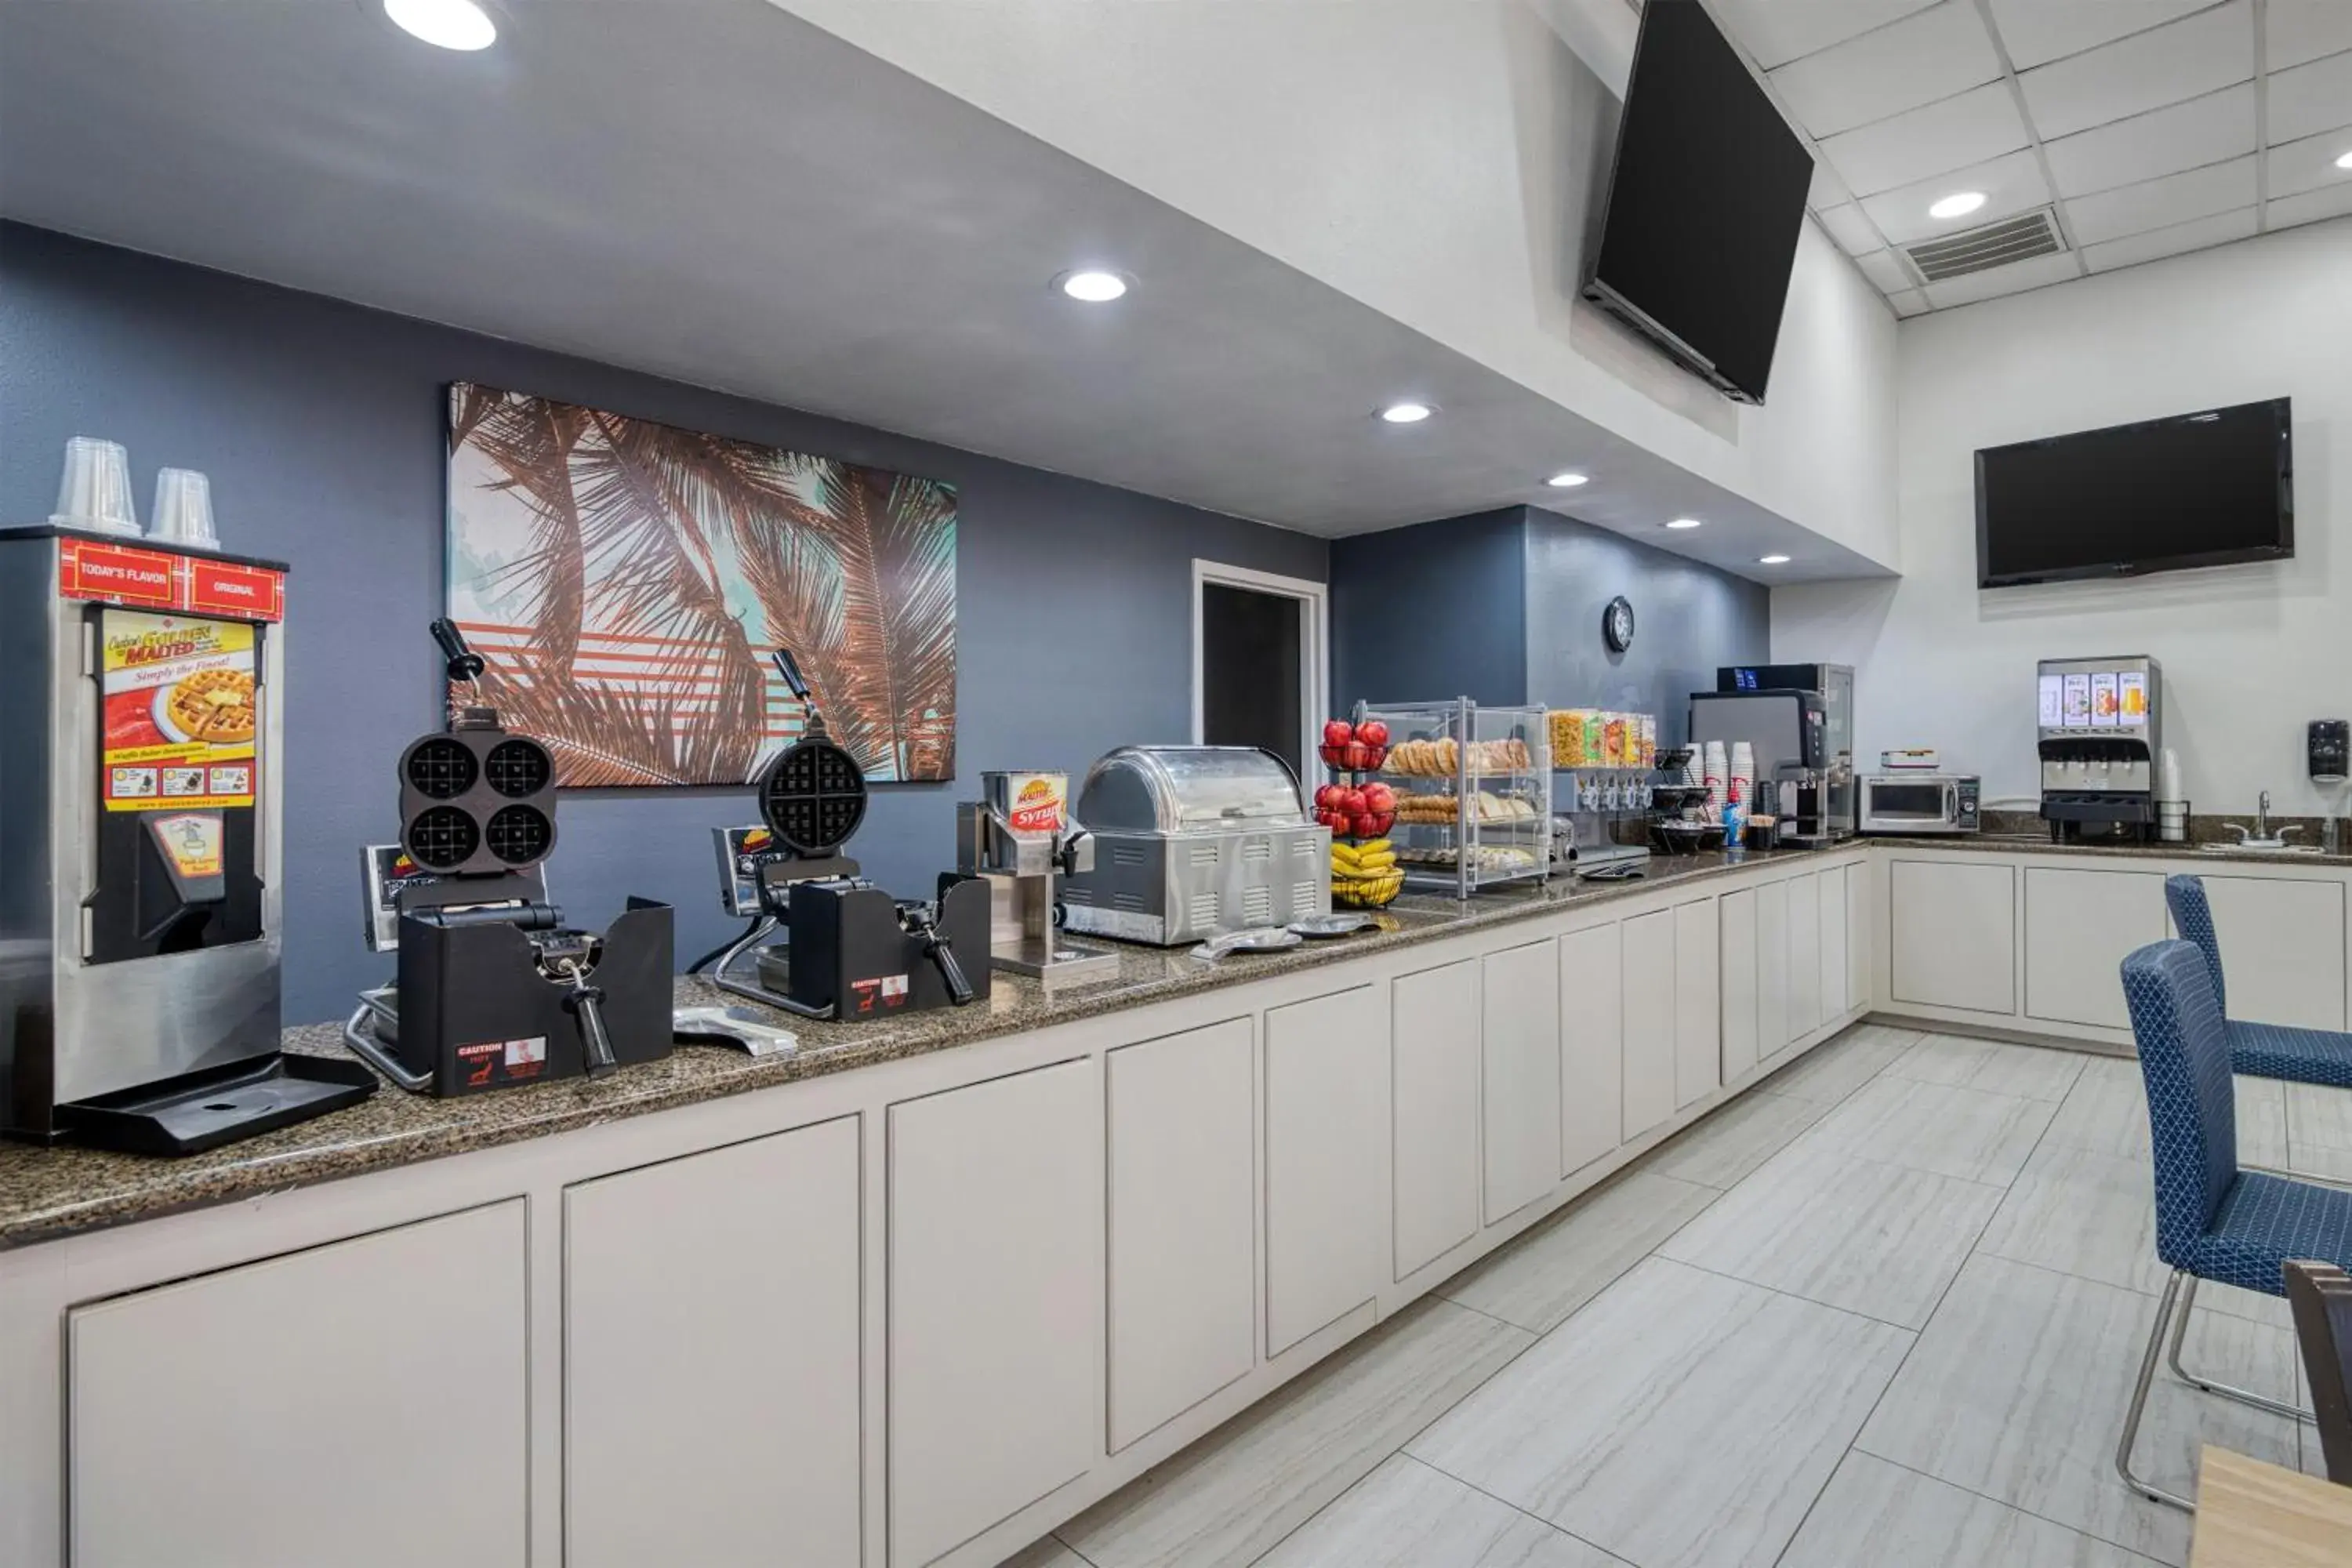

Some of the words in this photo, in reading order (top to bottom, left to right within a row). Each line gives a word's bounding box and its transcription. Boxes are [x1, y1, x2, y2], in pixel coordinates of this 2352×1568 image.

[81, 563, 125, 579] TODAY'S
[126, 568, 167, 585] FLAVOR
[125, 641, 195, 665] MALTED
[135, 665, 172, 683] Simply
[458, 1042, 502, 1056] CAUTION
